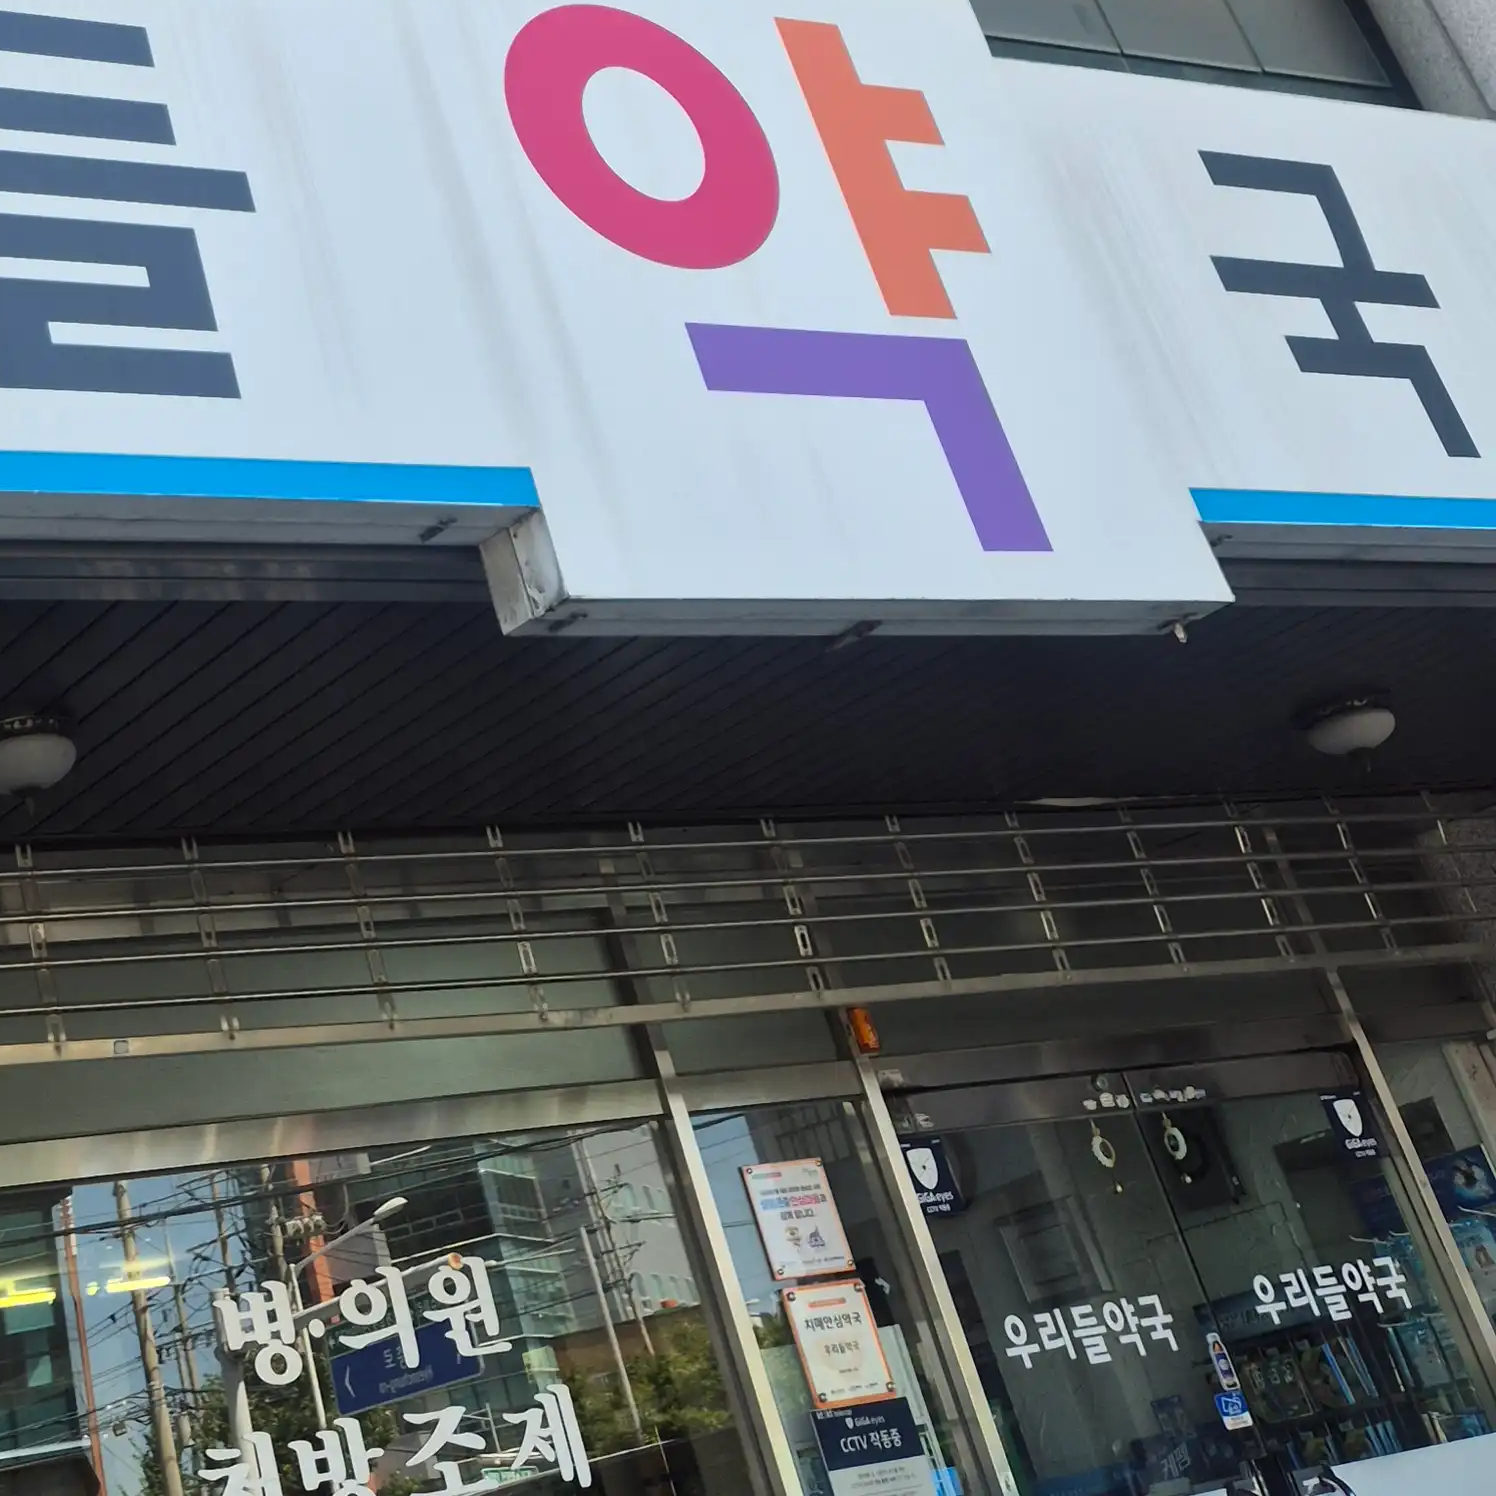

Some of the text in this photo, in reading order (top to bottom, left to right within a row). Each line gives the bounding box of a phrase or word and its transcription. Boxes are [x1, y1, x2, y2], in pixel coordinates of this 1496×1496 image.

[1253, 1255, 1413, 1325] 우리들약국
[1004, 1294, 1179, 1369] 우리들약국
[840, 1428, 903, 1453] CCTV 작동중
